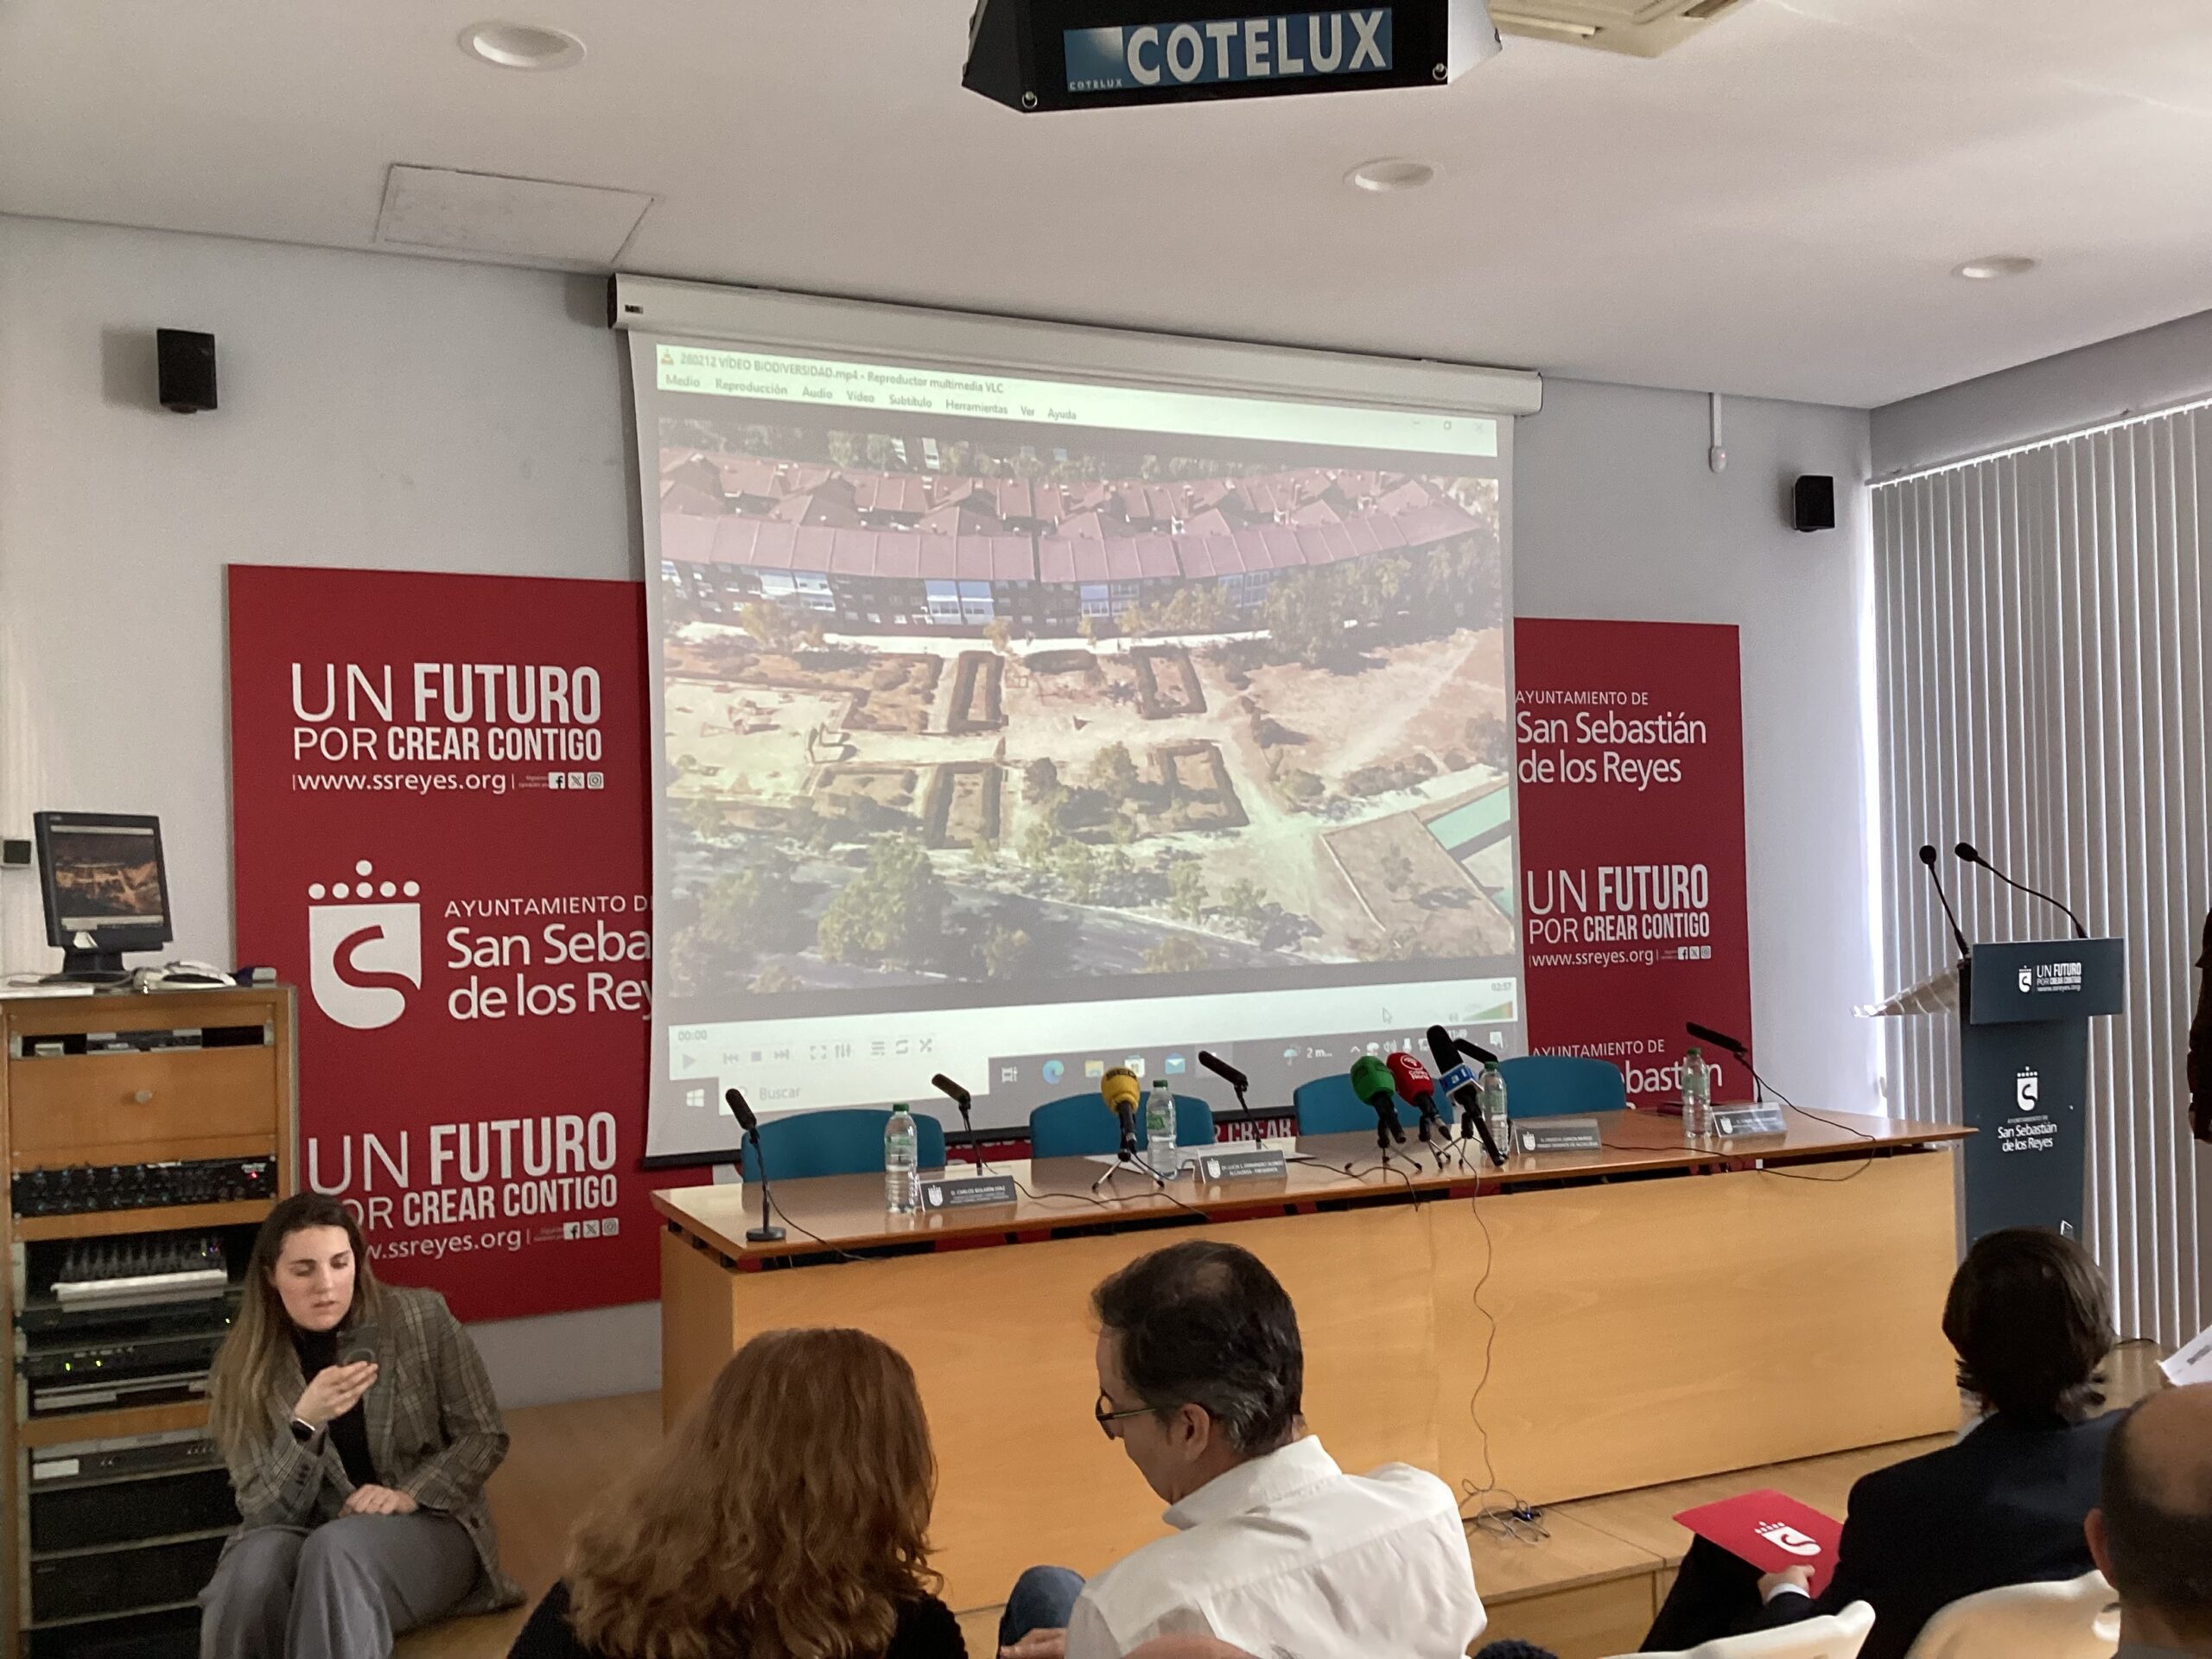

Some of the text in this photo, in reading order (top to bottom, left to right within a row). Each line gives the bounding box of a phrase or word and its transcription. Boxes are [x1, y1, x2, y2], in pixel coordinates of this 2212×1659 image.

[1126, 9, 1387, 86] COTELUX
[1069, 79, 1122, 91] COTELUX
[665, 373, 701, 388] Medio
[715, 378, 788, 396] Reproducción
[802, 386, 833, 399] Audio
[945, 398, 1008, 415] Herramientas
[1020, 405, 1035, 416] Ver
[1047, 407, 1077, 421] Ayuda
[867, 371, 928, 386] Reproductor
[929, 378, 983, 392] multimedia
[985, 382, 1004, 394] VLC
[291, 662, 601, 724] UN FUTURO
[1515, 690, 1649, 705] AYUNTAMIENTO DE
[1516, 710, 1707, 744] San Sebastián
[294, 726, 602, 762] POR CREAR CONTIGO
[296, 770, 506, 796] www.ssreyes.org
[1517, 748, 1682, 791] de los Reyes
[1527, 863, 1709, 915] UN FUTURO
[444, 894, 652, 918] AYUNTAMIENTO D
[1529, 912, 1710, 944] POR CREAR CONTIGO
[446, 926, 531, 969] San
[1531, 948, 1654, 967] www.ssreyes.org
[2037, 962, 2082, 978] UN FUTURO
[448, 976, 506, 1020] de
[518, 973, 576, 1016] los
[677, 1029, 708, 1042] 00:00
[1648, 1039, 1665, 1053] DE
[1306, 1047, 1313, 1058] 2
[759, 1085, 801, 1101] Buscar
[1998, 1122, 2057, 1139] San Sebastián
[2002, 1136, 2053, 1152] de los Reyes
[308, 1111, 617, 1196] UN FUTURO
[340, 1173, 618, 1230] OR CREAR CONTIGO
[367, 1228, 522, 1260] w.ssreyes.org
